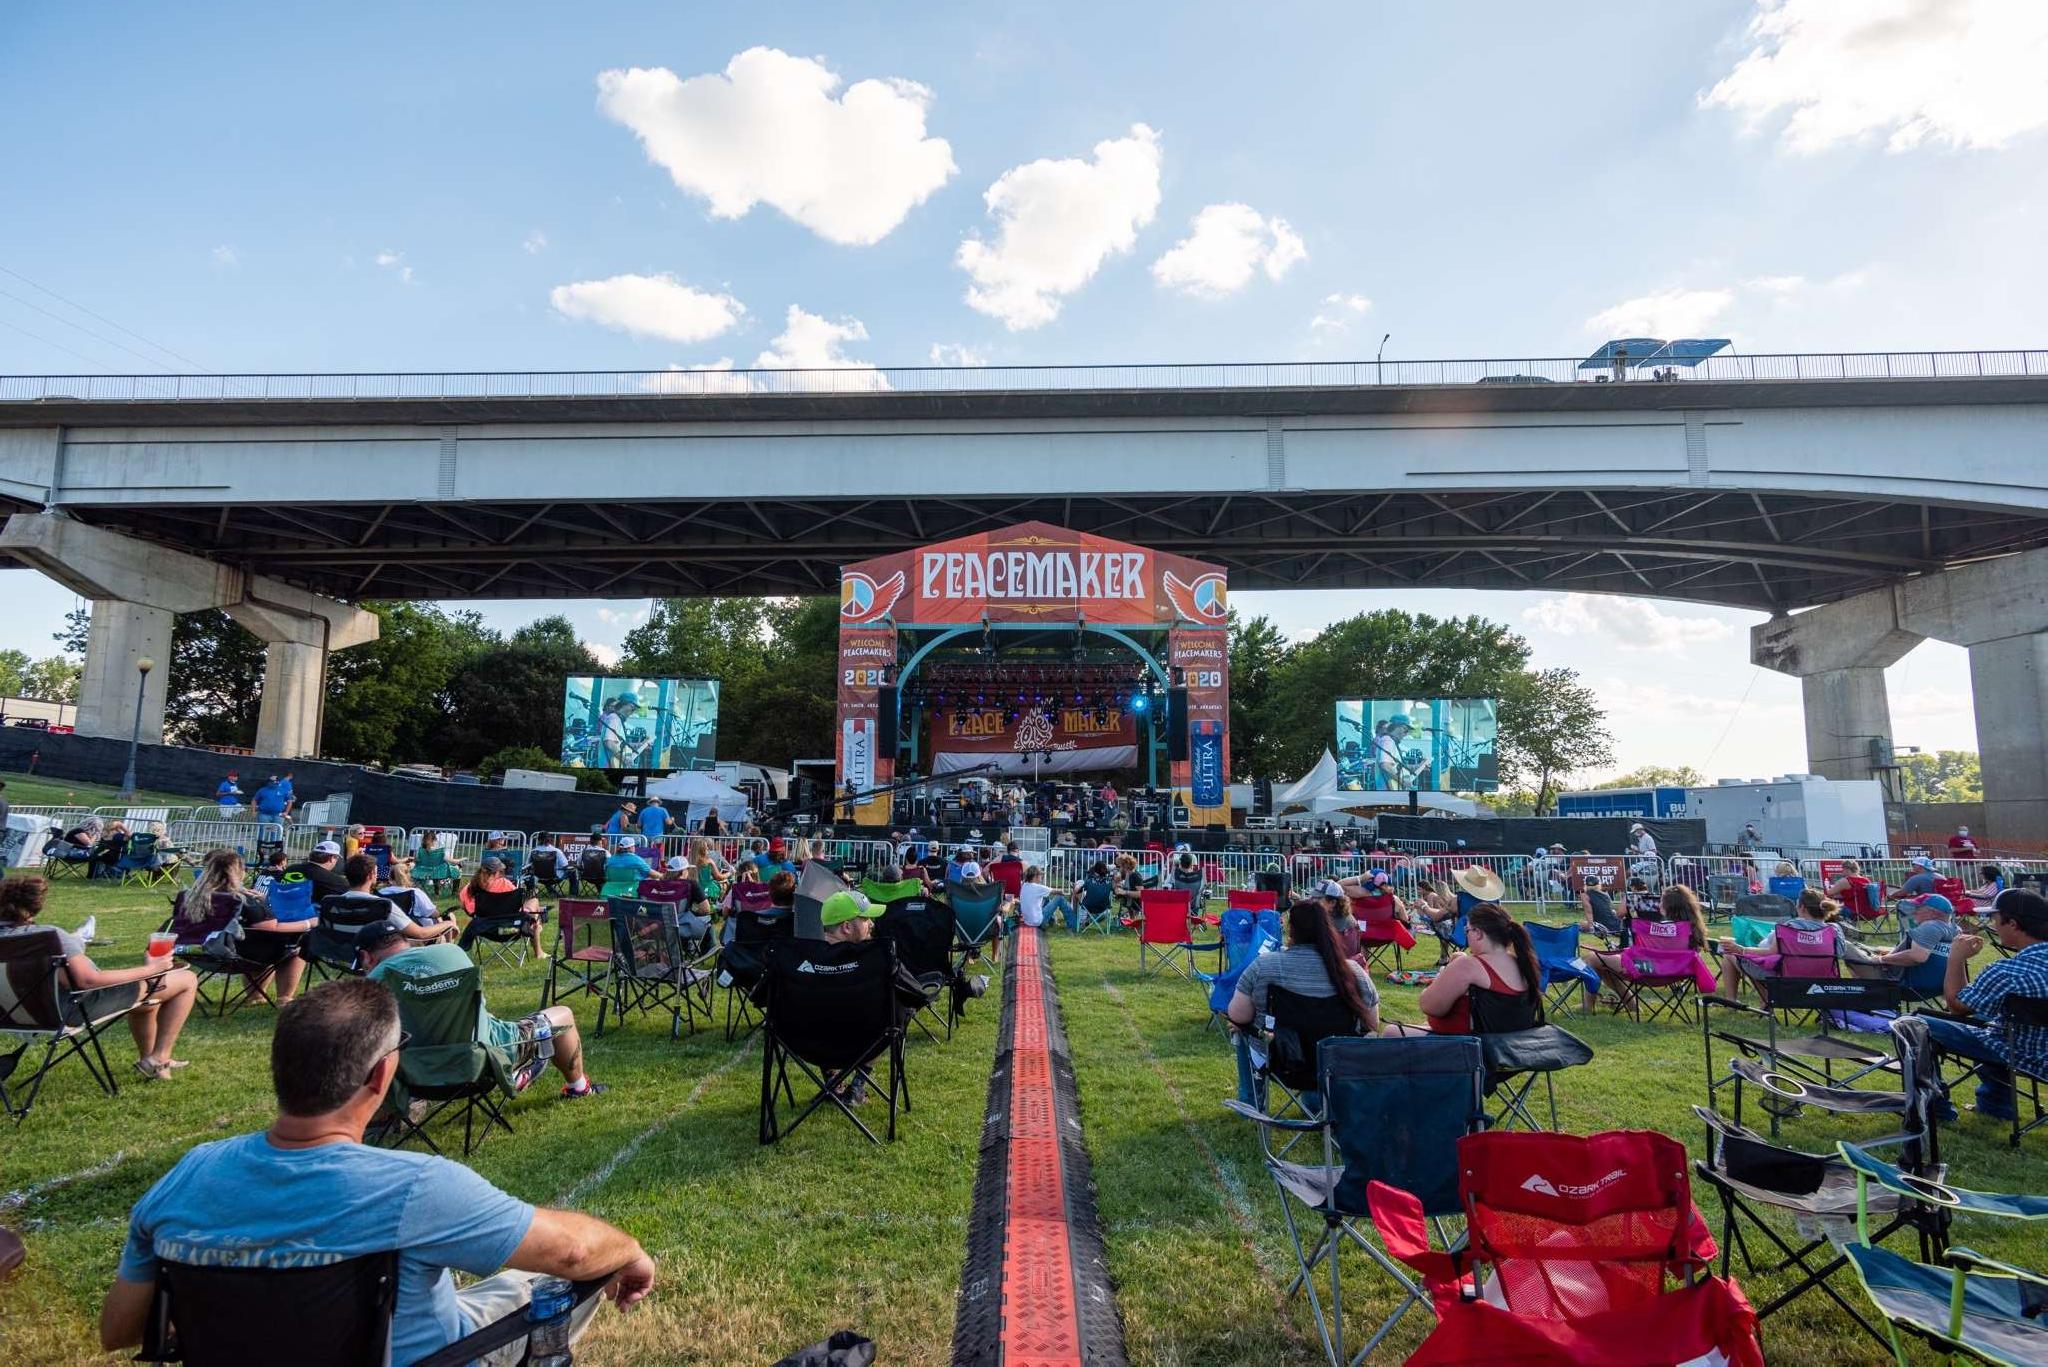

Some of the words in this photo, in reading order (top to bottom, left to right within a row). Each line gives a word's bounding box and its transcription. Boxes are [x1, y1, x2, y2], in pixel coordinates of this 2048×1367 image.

[922, 552, 1146, 599] PEACEMAKER
[843, 648, 892, 657] PEACEMAKERS
[850, 639, 885, 647] WELCOME
[1180, 641, 1215, 649] WELCOME
[1174, 649, 1223, 659] PEACEMAKERS
[949, 712, 1005, 735] PEACE
[1063, 711, 1121, 732] MAKER
[855, 738, 865, 787] ULTRA
[1203, 740, 1213, 789] ULTRA
[1577, 866, 1600, 875] KEEP
[1558, 1179, 1600, 1195] OZARK
[1599, 1169, 1628, 1185] TRAIL
